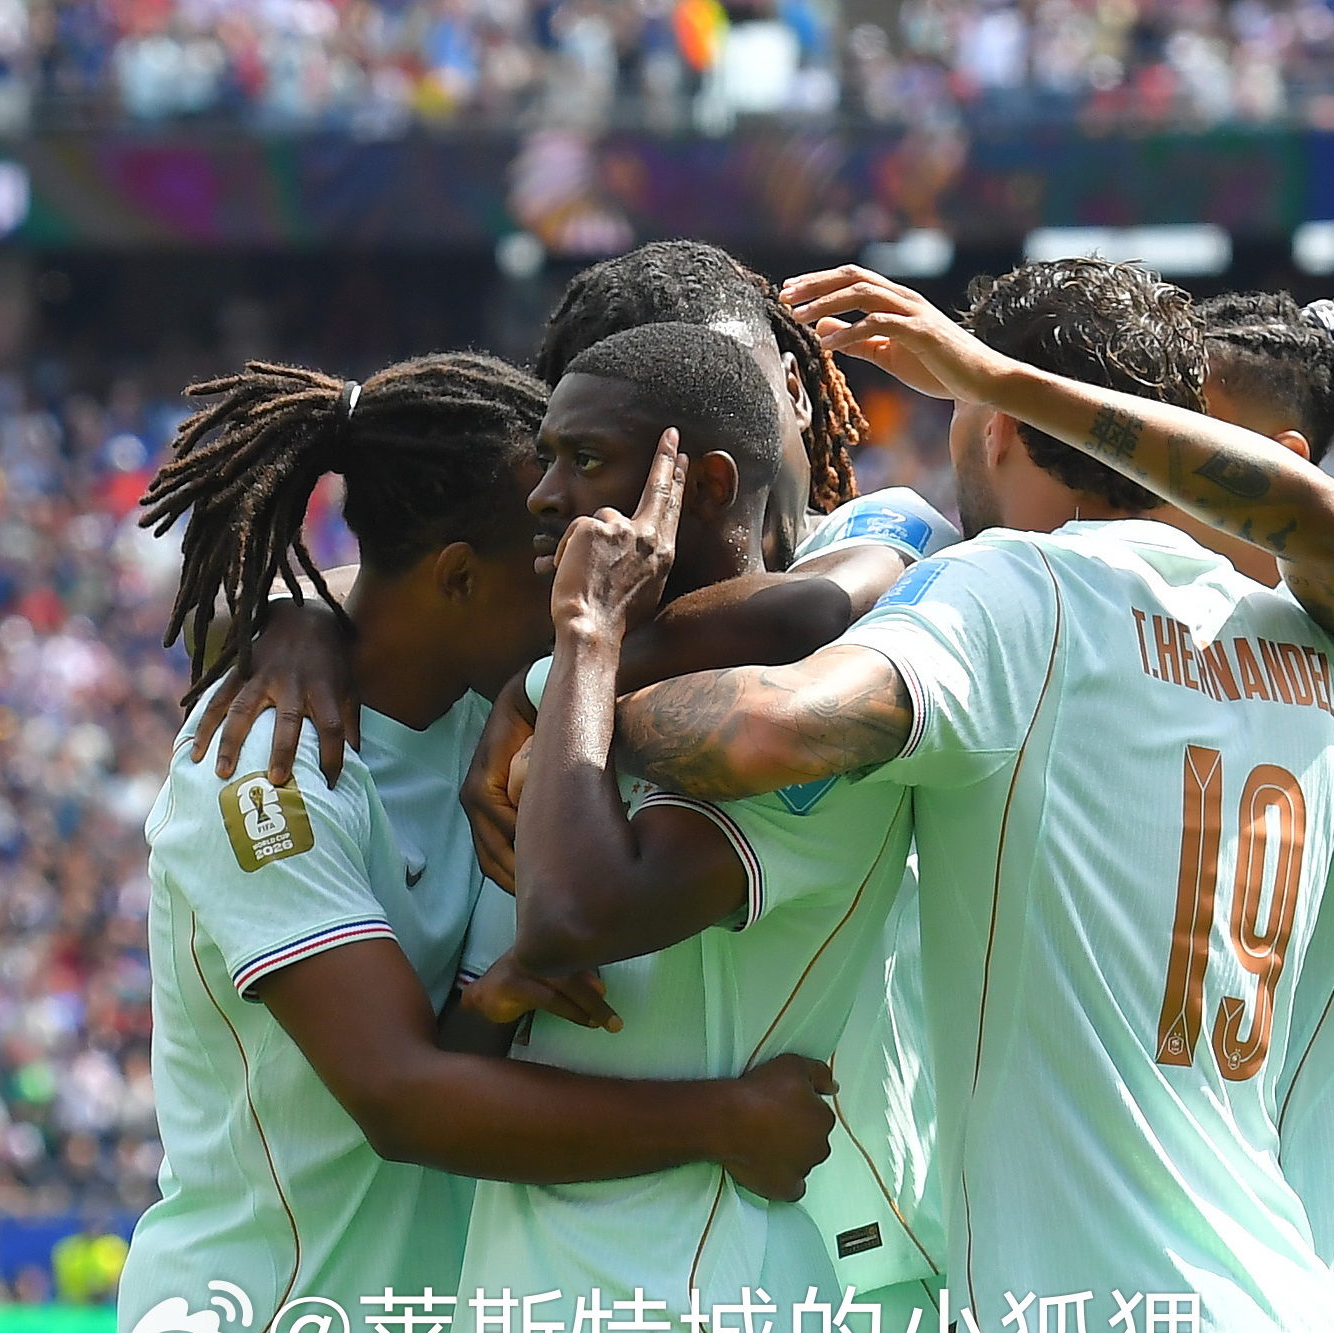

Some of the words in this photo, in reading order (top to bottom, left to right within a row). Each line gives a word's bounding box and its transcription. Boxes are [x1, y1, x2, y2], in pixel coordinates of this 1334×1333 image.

[257, 822, 276, 834] FIFA
[252, 837, 276, 851] WORLD
[275, 832, 291, 842] CUP
[255, 839, 294, 861] 2026
[1156, 744, 1307, 1082] 19
